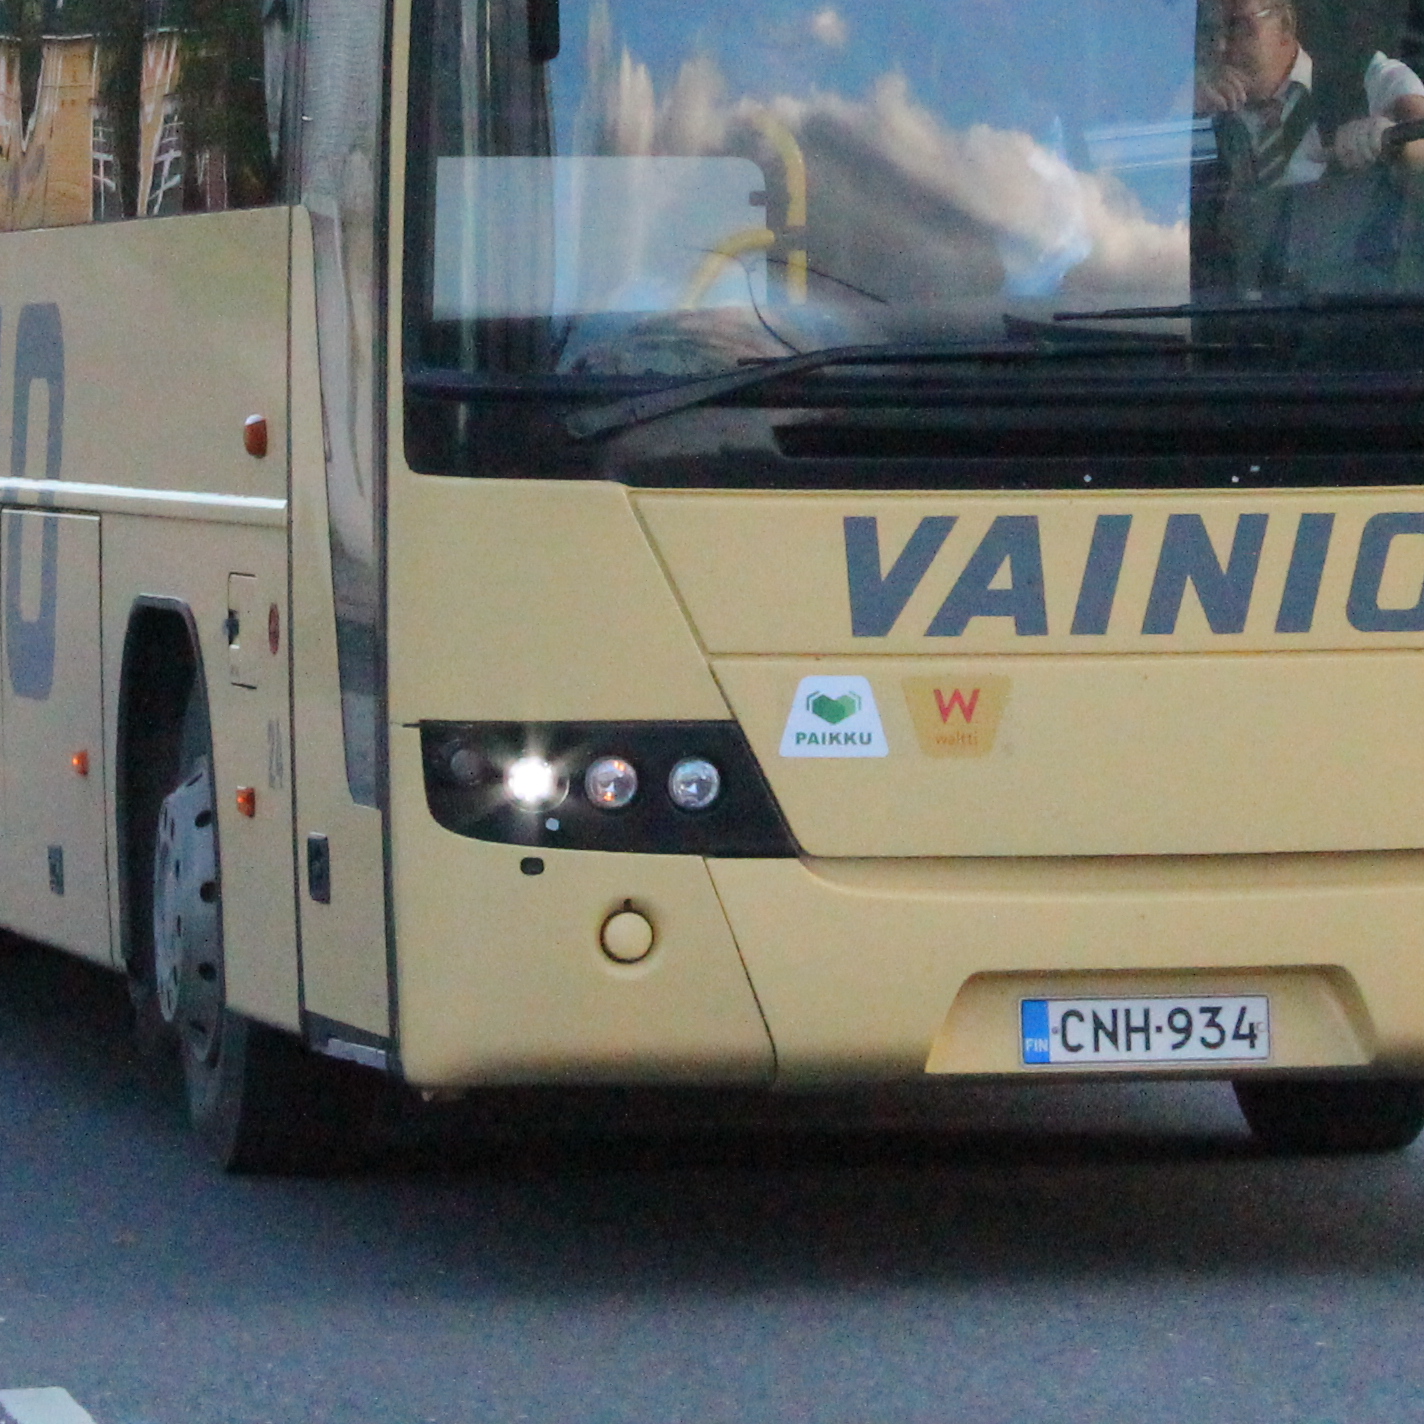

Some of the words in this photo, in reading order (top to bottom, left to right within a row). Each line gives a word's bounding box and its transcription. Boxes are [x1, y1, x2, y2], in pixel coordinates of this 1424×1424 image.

[933, 688, 980, 724] W
[795, 731, 872, 745] PAIKKU
[935, 730, 978, 745] waltti
[1060, 1006, 1258, 1053] CNH-934
[1026, 1038, 1048, 1052] FIN
